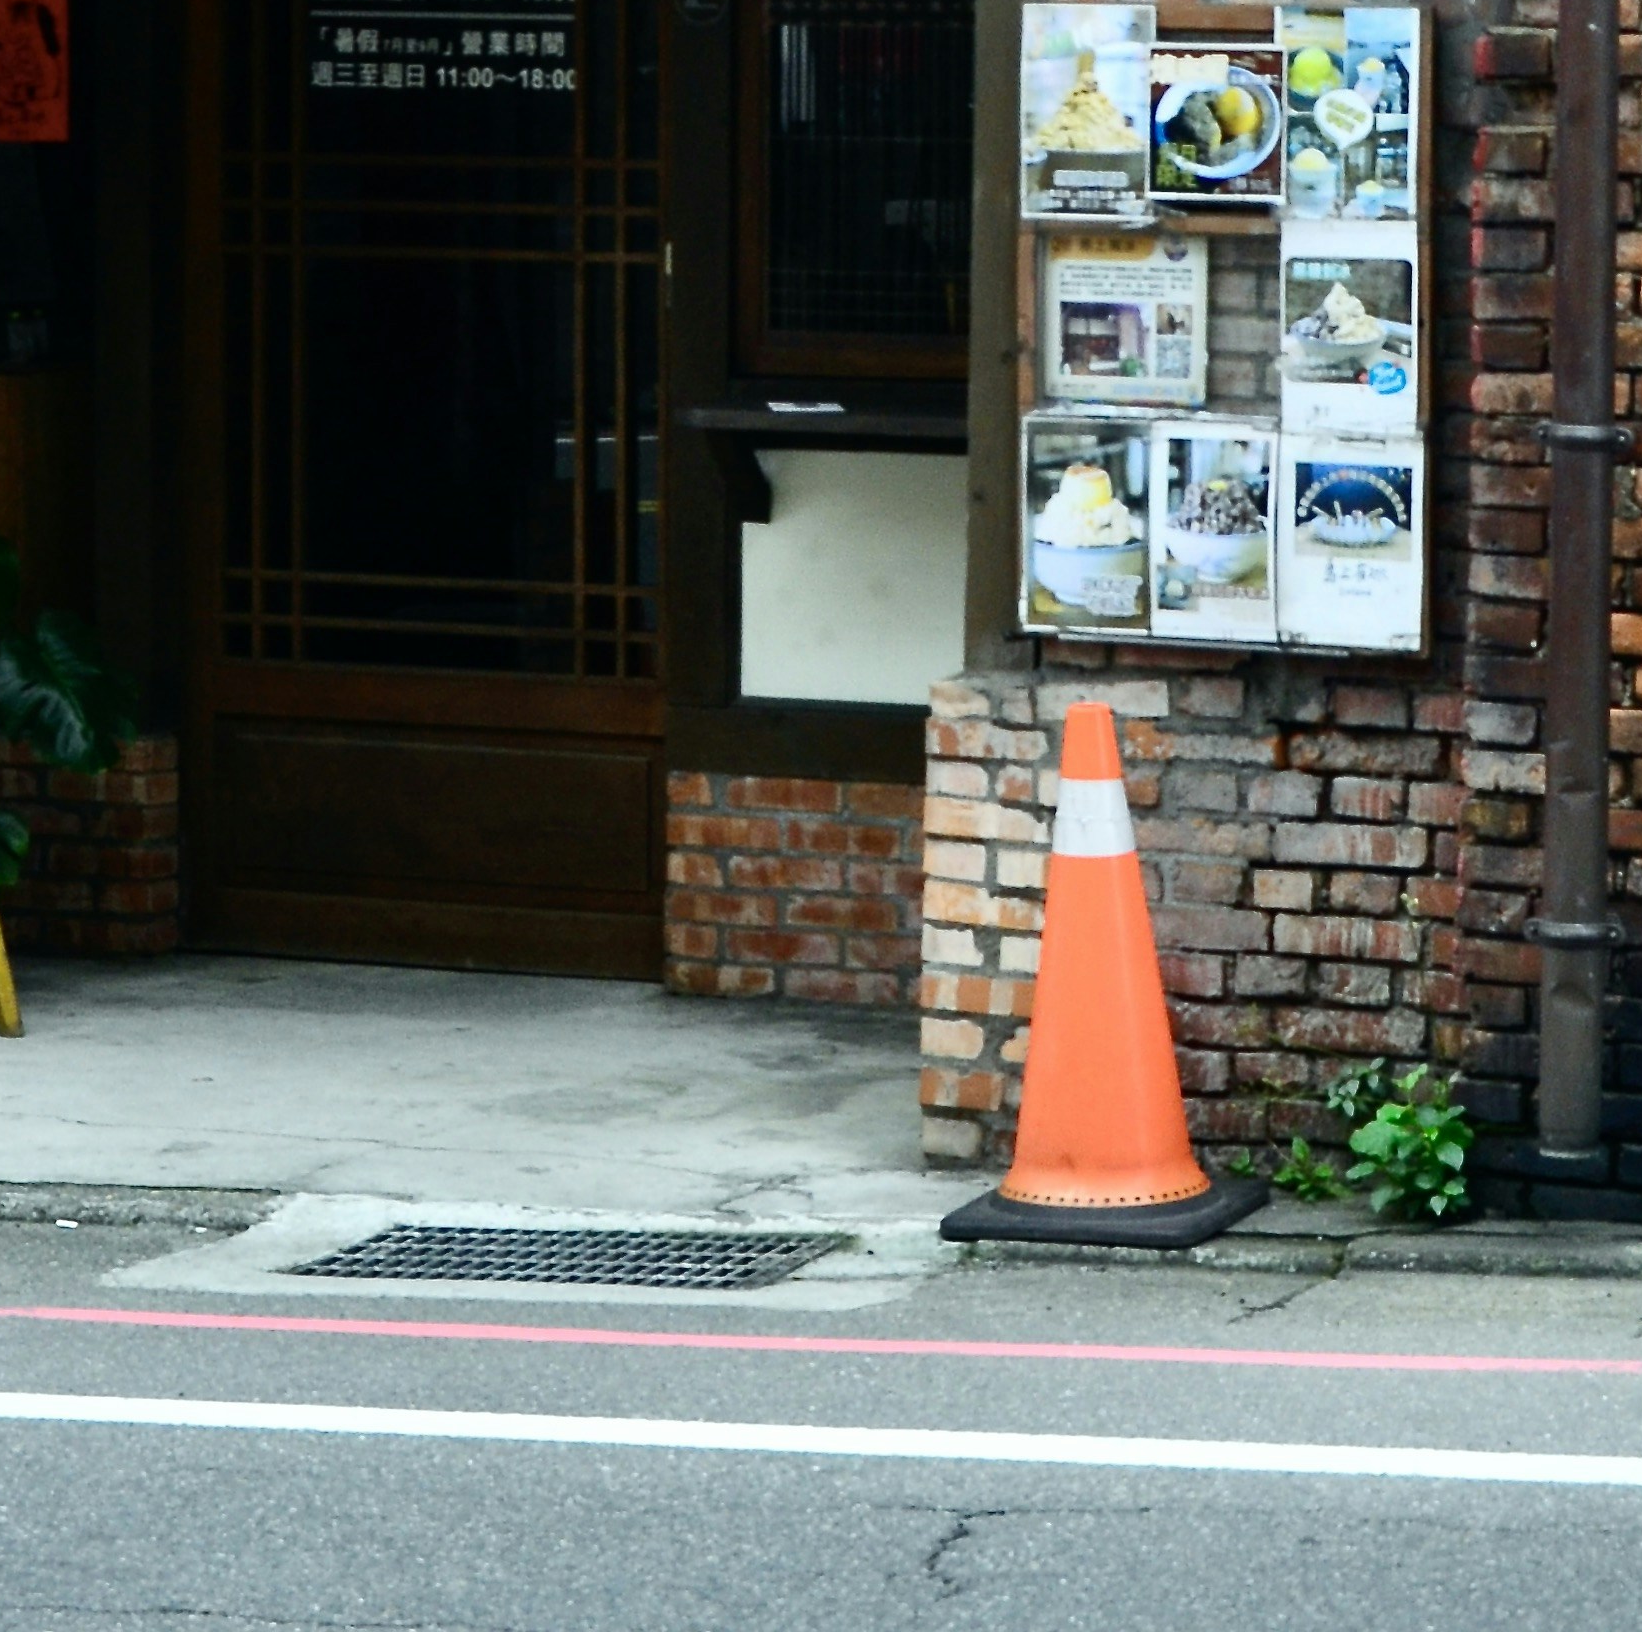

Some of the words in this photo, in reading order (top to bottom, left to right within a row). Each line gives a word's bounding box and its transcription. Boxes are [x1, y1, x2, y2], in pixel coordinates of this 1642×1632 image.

[312, 61, 426, 90] 週三至週日
